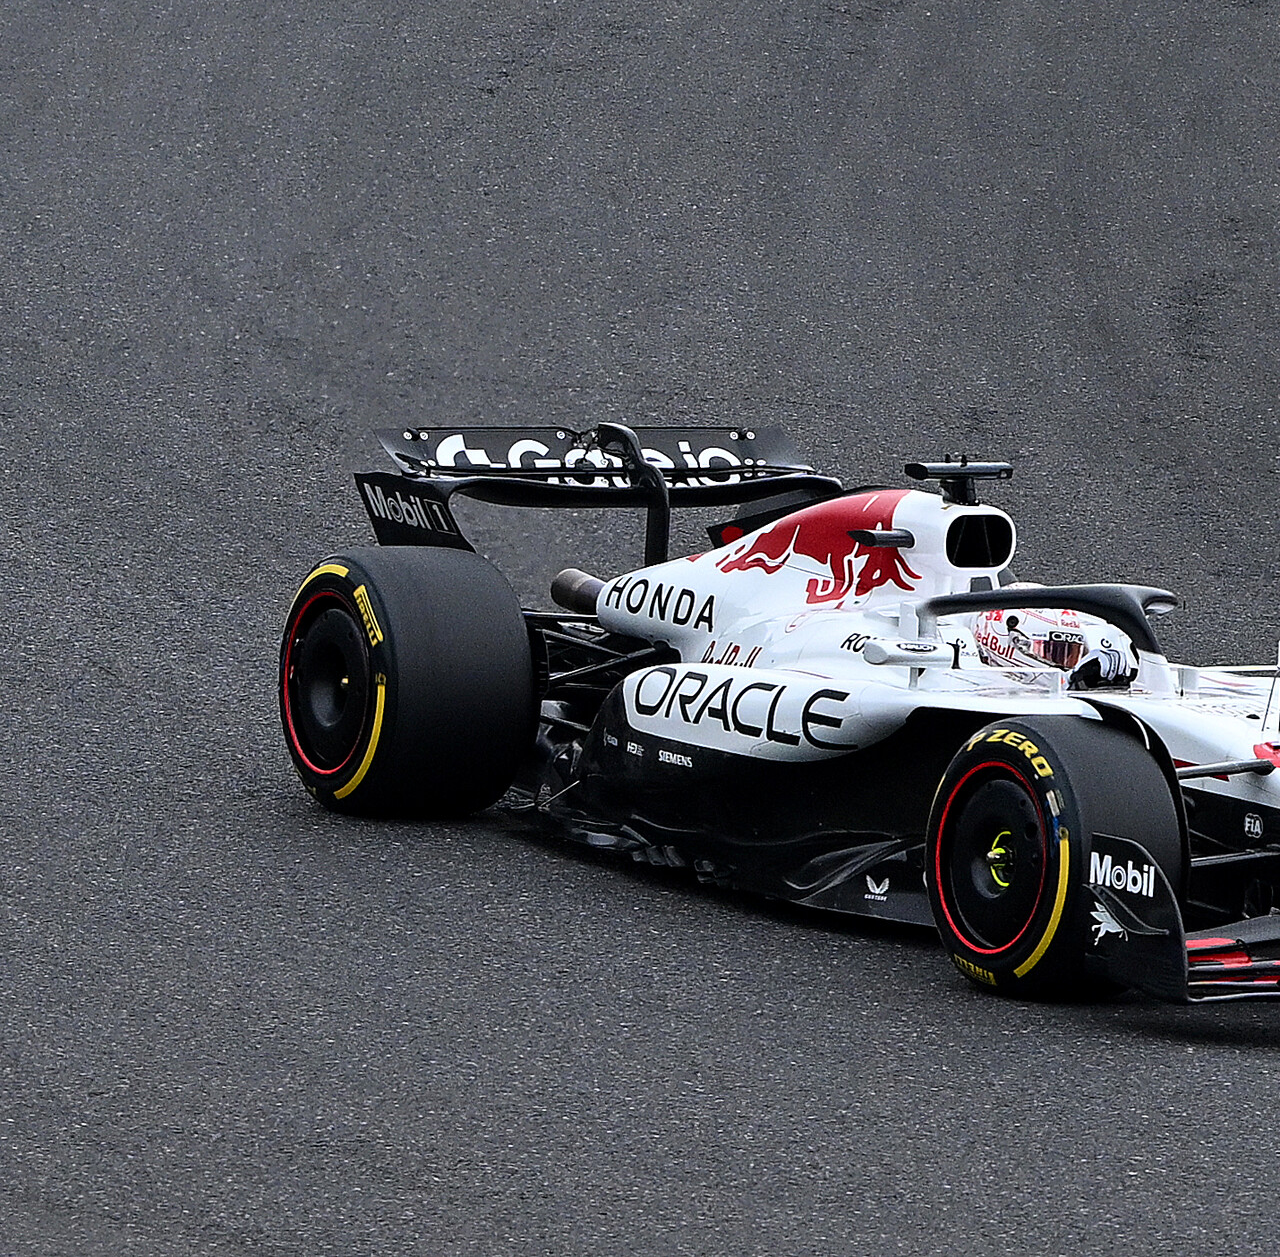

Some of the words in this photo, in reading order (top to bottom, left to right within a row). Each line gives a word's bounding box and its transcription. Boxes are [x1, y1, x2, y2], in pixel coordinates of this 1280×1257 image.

[363, 483, 432, 531] Mobil
[605, 576, 714, 633] HONDA
[635, 666, 858, 751] ORACLE
[658, 749, 693, 768] SIEMENS
[986, 729, 1055, 777] ZERO
[1089, 851, 1155, 898] Mobil
